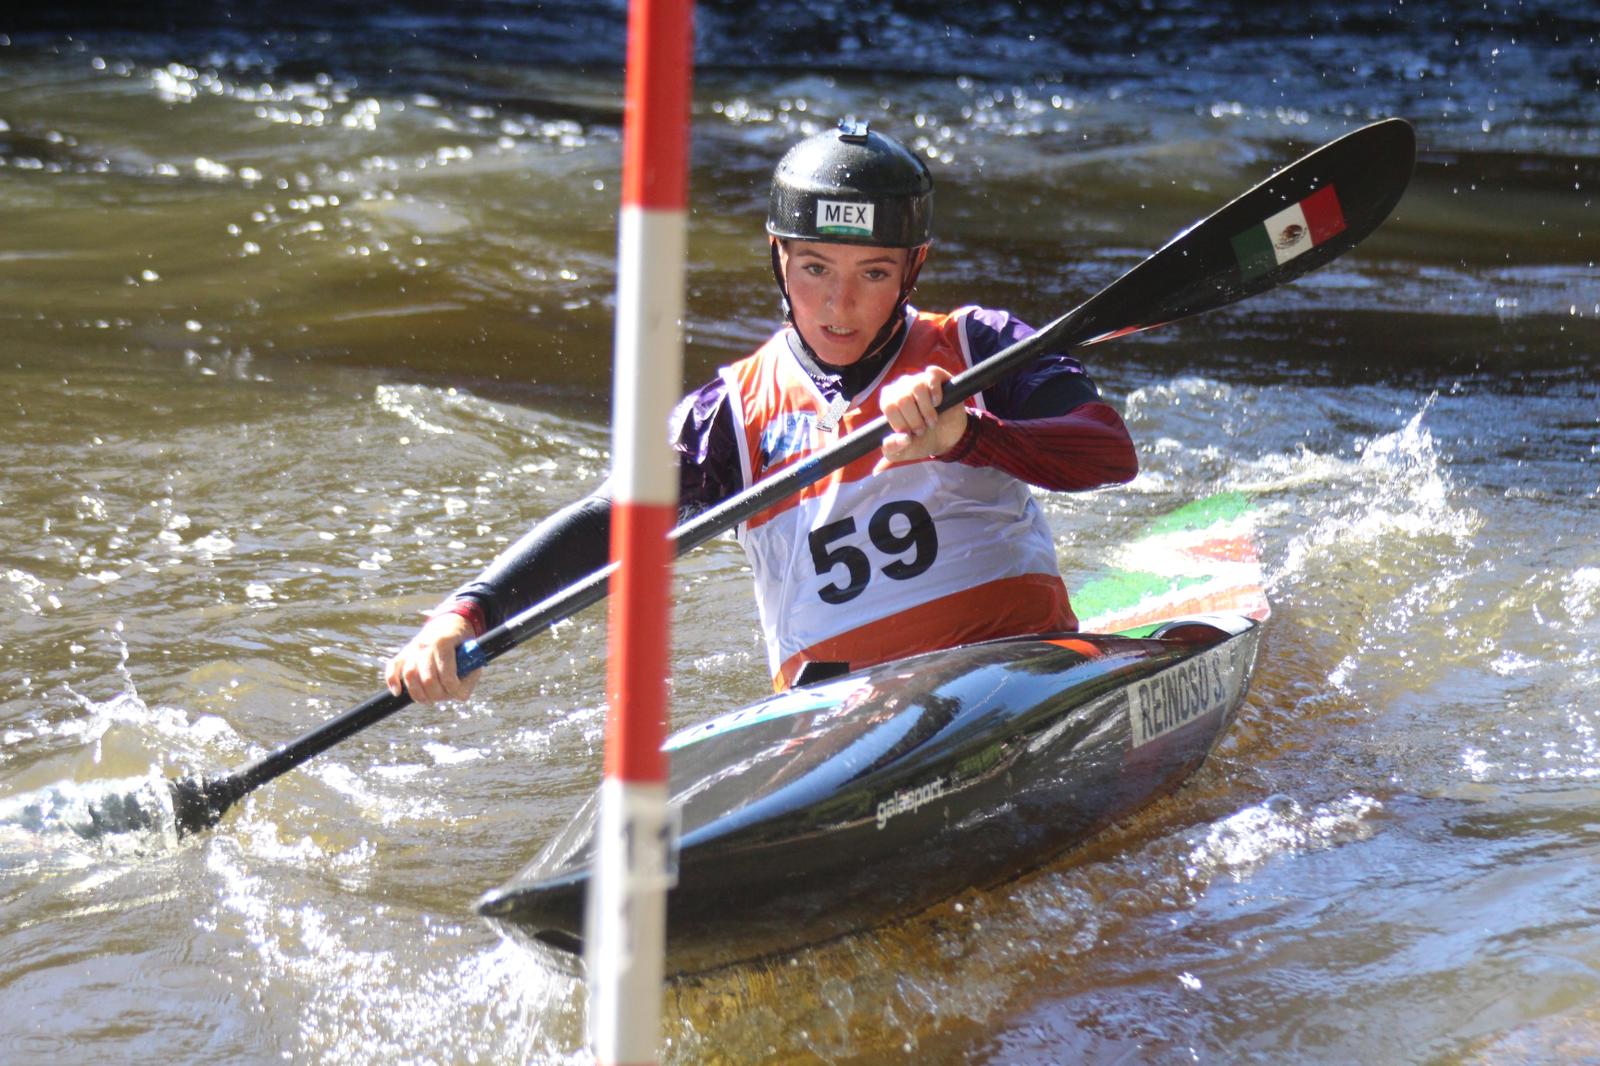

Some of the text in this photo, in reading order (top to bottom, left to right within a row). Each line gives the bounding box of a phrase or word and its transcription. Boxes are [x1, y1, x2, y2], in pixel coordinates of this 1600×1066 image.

[825, 204, 866, 224] MEX
[808, 500, 938, 605] 59
[1138, 656, 1209, 740] REINOSO
[876, 776, 945, 830] galasport
